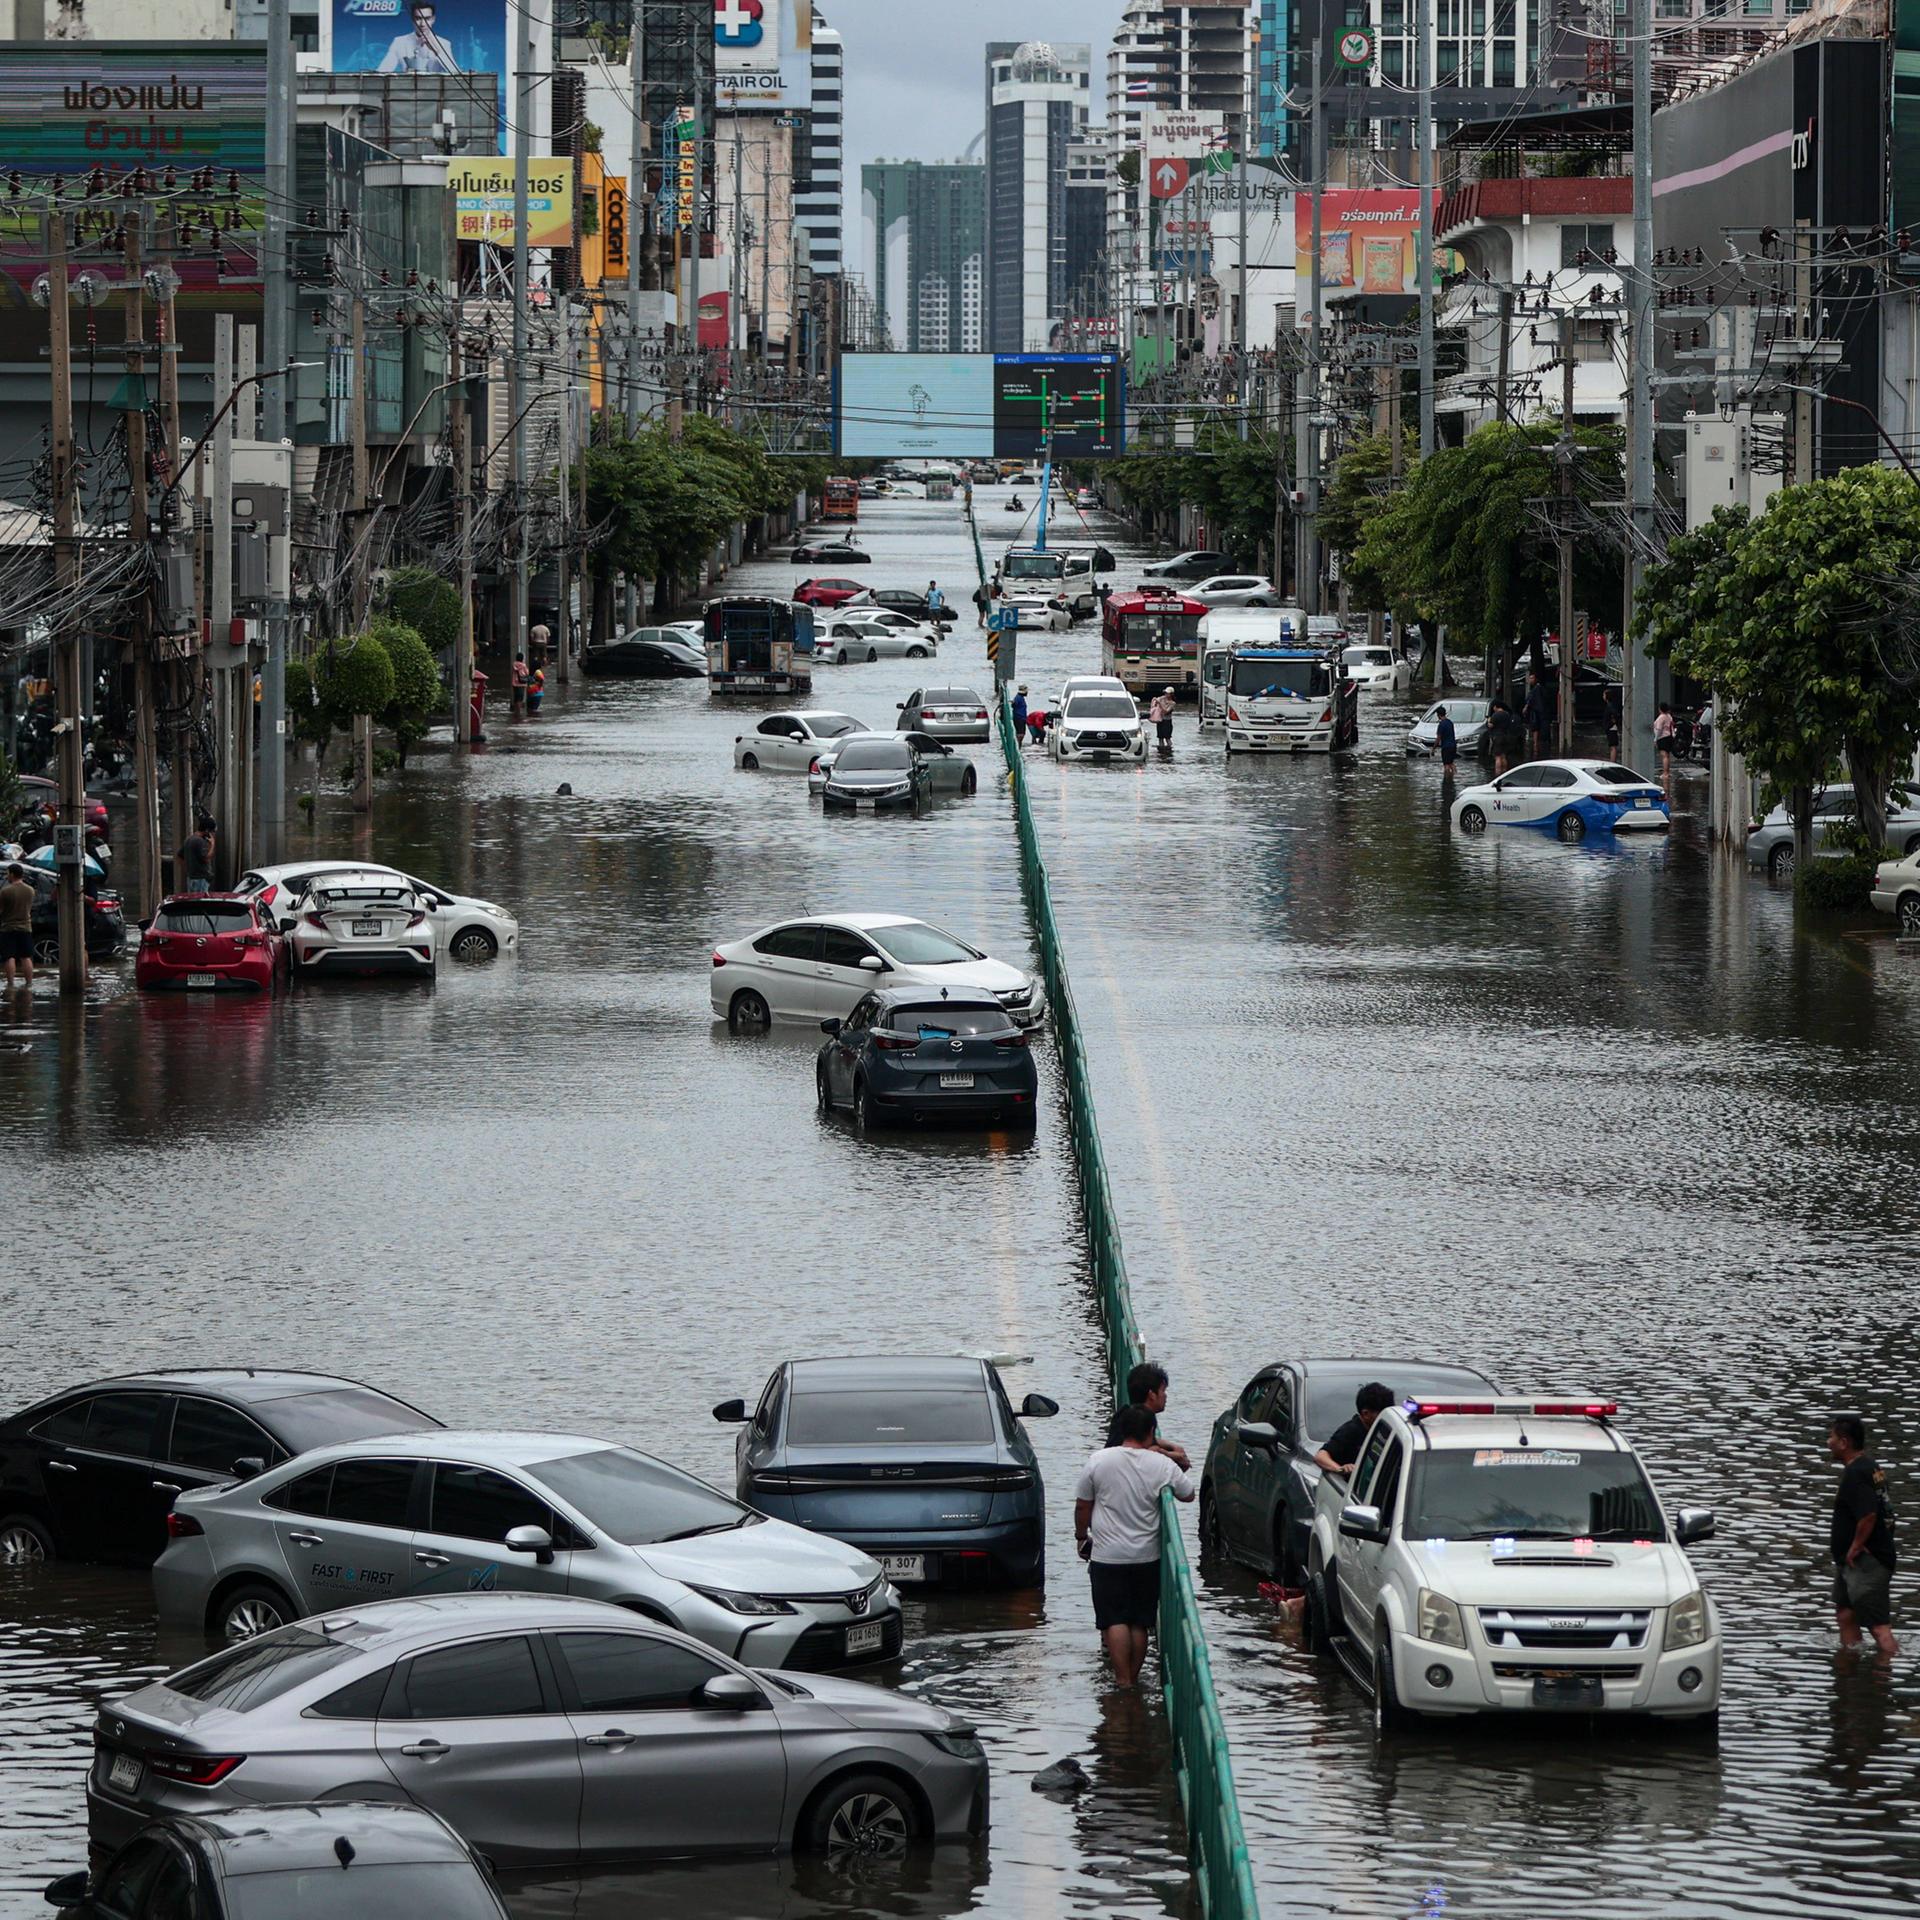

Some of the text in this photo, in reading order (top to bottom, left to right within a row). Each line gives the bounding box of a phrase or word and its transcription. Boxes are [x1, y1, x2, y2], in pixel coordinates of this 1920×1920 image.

[363, 1, 396, 11] DR80
[759, 76, 788, 88] OIL
[64, 74, 203, 110] ฟองแน่น
[896, 1557, 917, 1568] 307
[311, 1563, 342, 1578] FAST
[359, 1569, 395, 1585] FIRST
